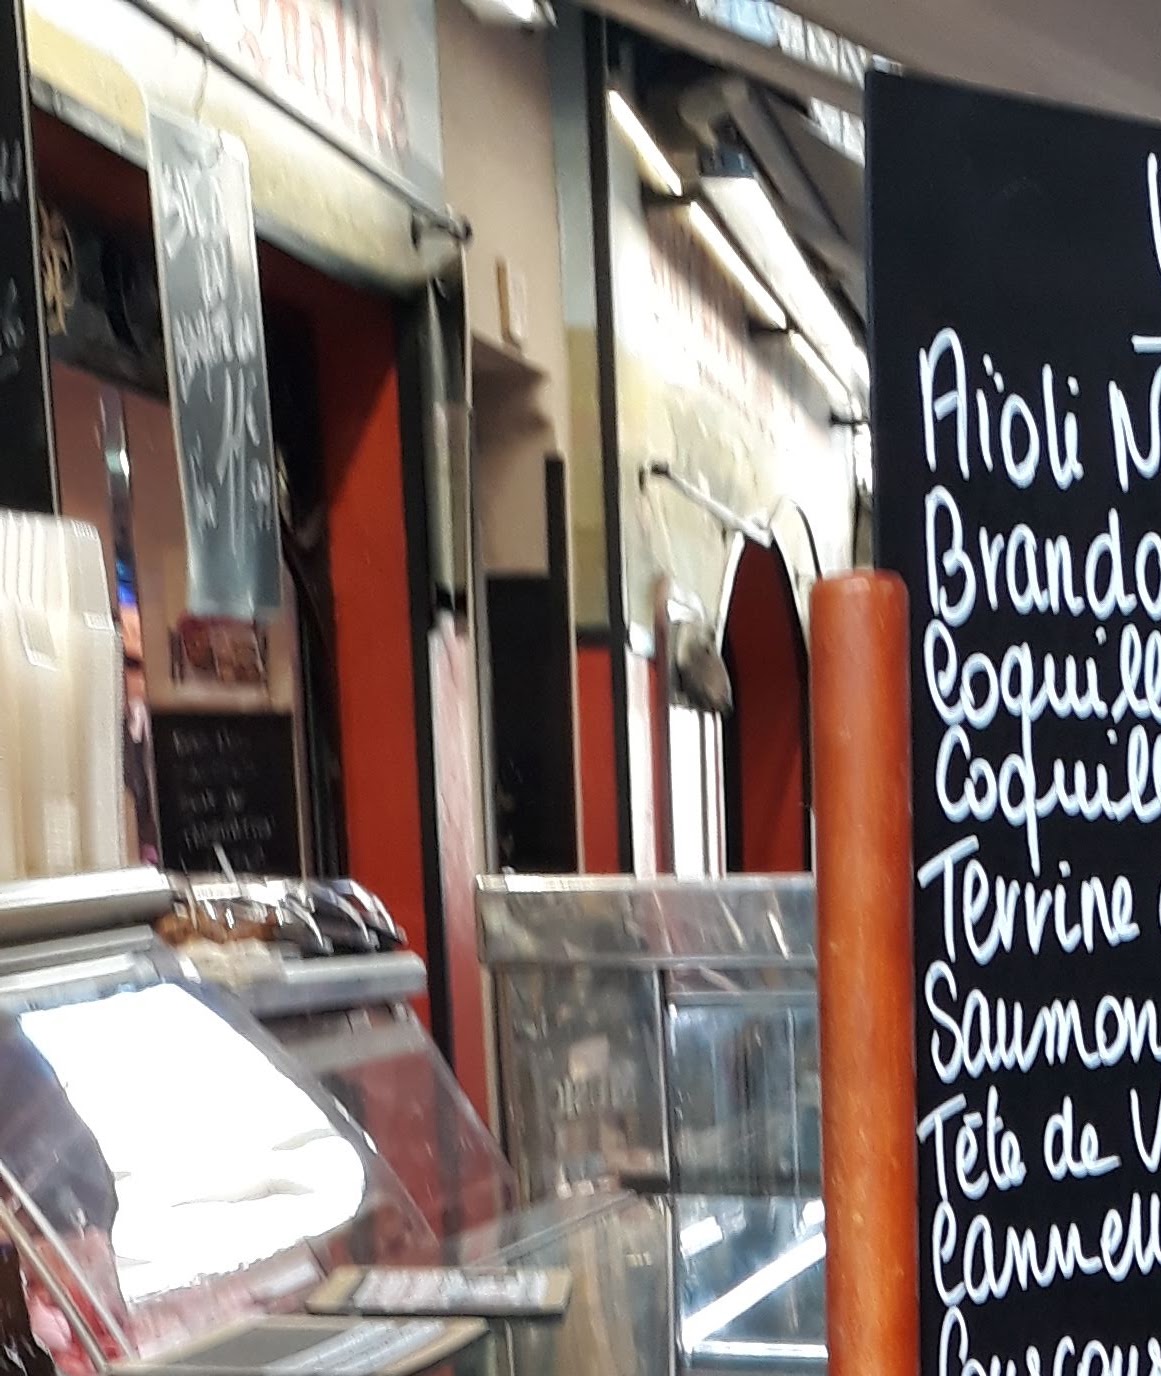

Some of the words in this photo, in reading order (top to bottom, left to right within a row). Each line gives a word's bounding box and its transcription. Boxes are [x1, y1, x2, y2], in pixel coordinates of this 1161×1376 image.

[919, 328, 1085, 491] Aïoli
[918, 835, 1140, 964] Terrine
[917, 1094, 1026, 1200] Tête
[1044, 1096, 1119, 1179] de
